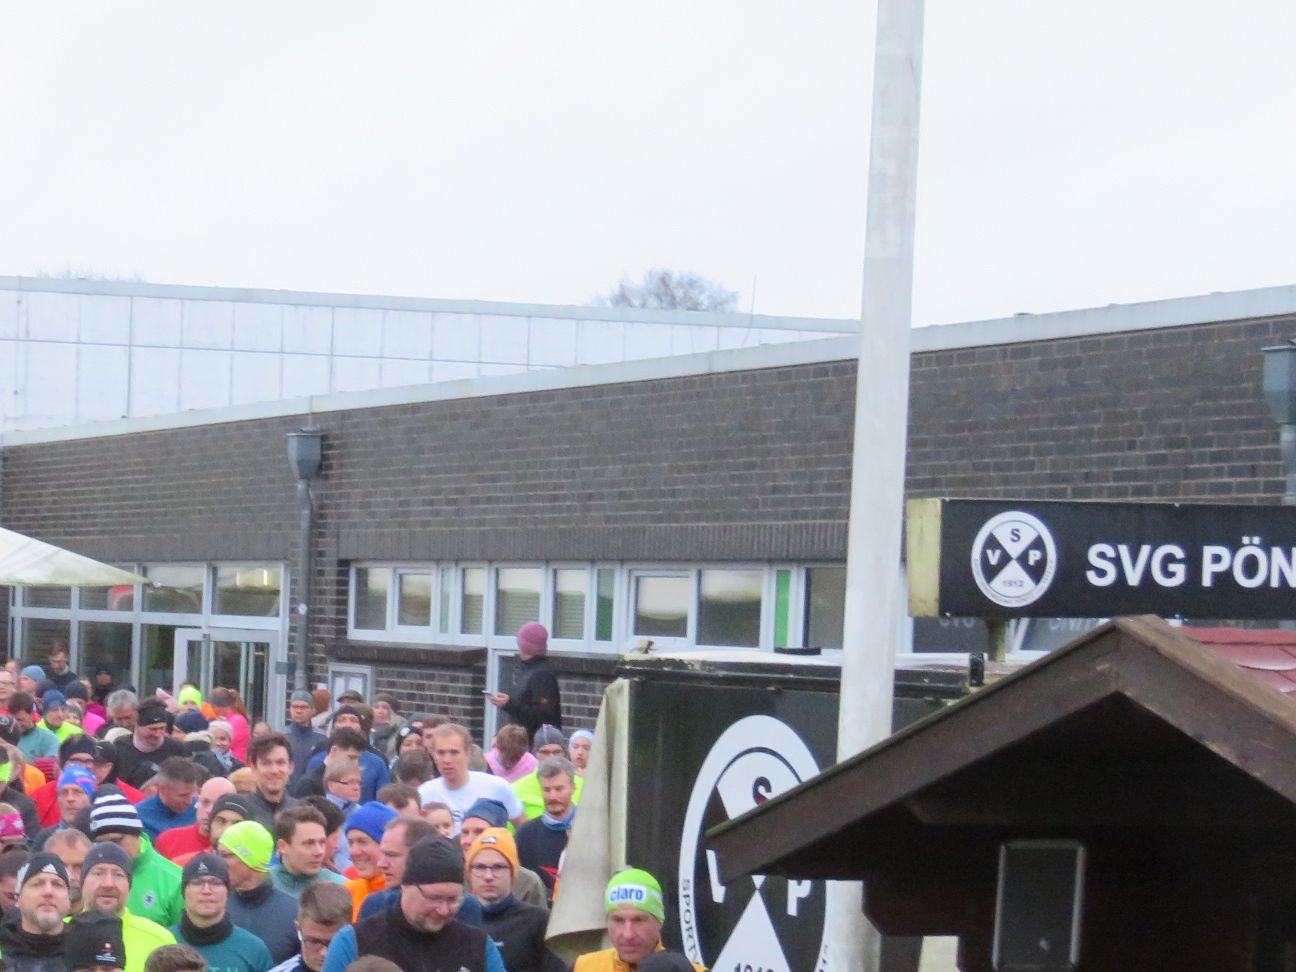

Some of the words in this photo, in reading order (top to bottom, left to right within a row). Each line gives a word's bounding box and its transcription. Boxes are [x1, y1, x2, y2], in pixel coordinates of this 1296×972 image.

[1085, 543, 1187, 587] SVG
[1202, 536, 1296, 588] PÖN
[610, 887, 643, 902] claro
